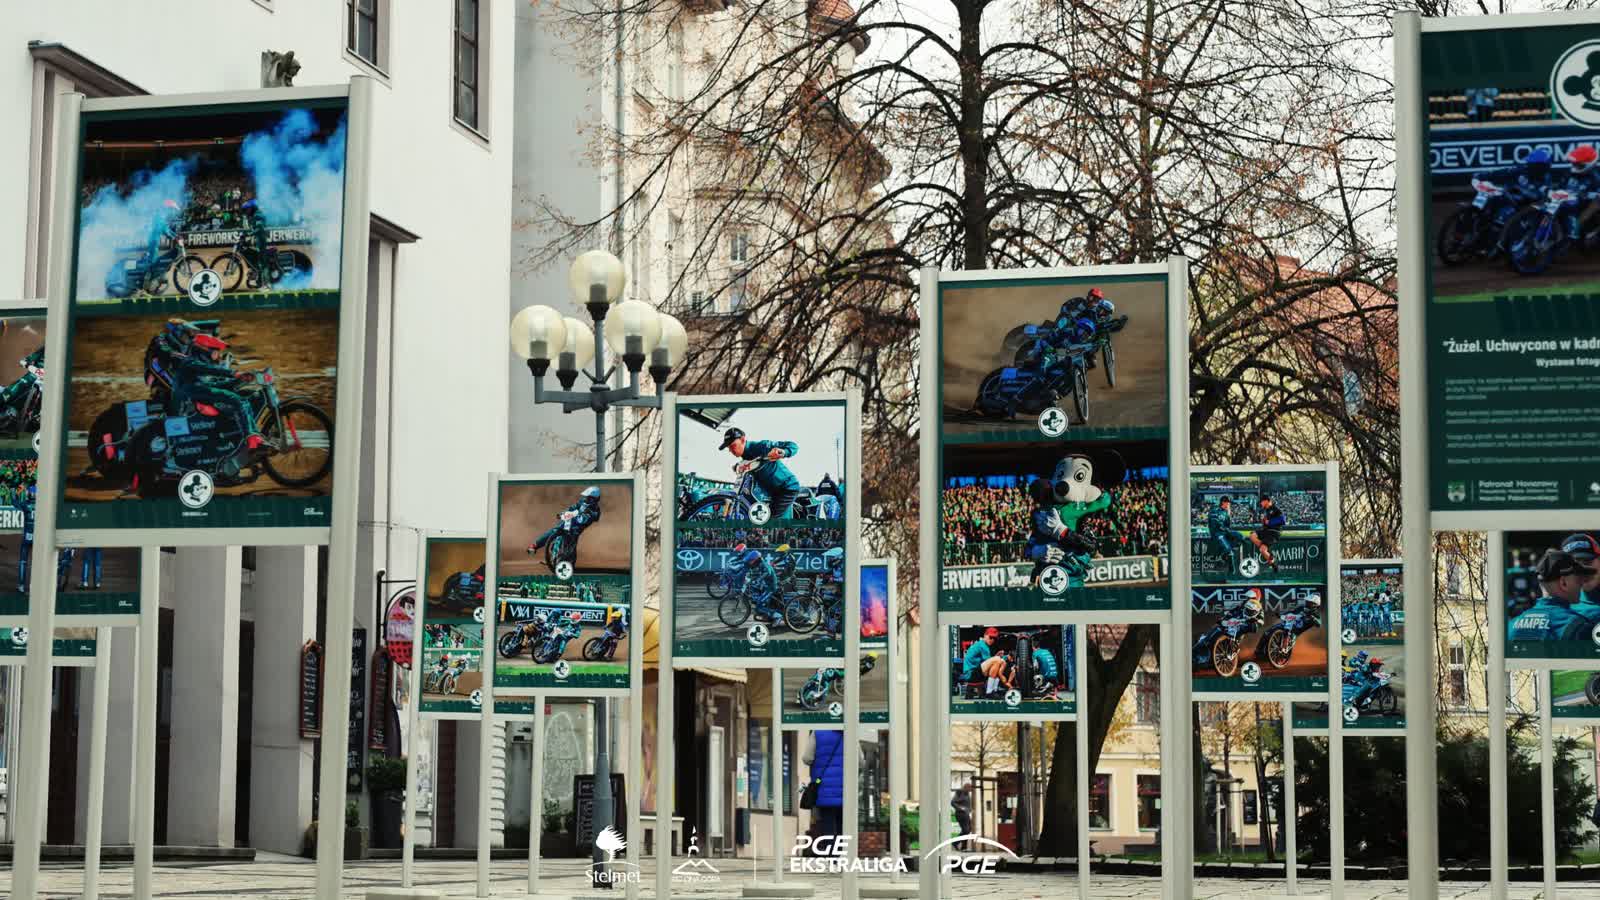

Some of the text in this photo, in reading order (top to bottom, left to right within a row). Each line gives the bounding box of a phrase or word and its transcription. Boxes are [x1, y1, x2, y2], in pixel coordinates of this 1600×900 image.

[188, 231, 241, 246] FIREWORKS
[1486, 339, 1557, 354] Uchwycone
[1560, 340, 1571, 350] w
[1083, 560, 1147, 582] telmet
